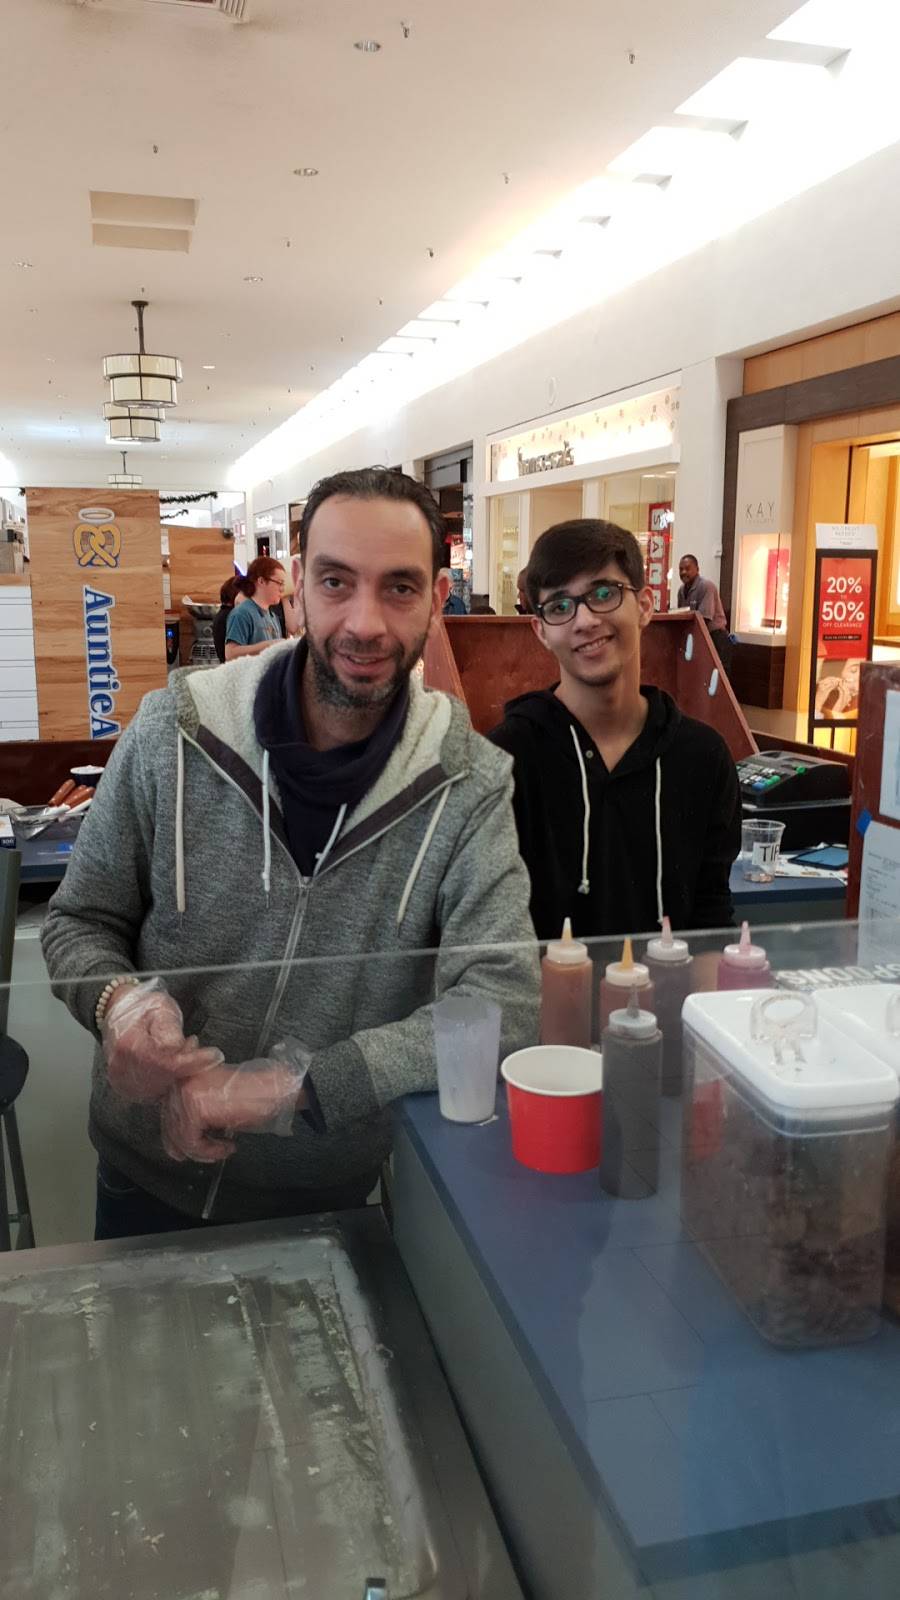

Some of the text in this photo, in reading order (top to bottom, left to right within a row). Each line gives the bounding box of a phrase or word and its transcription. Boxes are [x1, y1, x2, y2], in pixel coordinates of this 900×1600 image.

[745, 501, 775, 519] KAY
[826, 576, 862, 593] 20%
[822, 601, 865, 621] 50%
